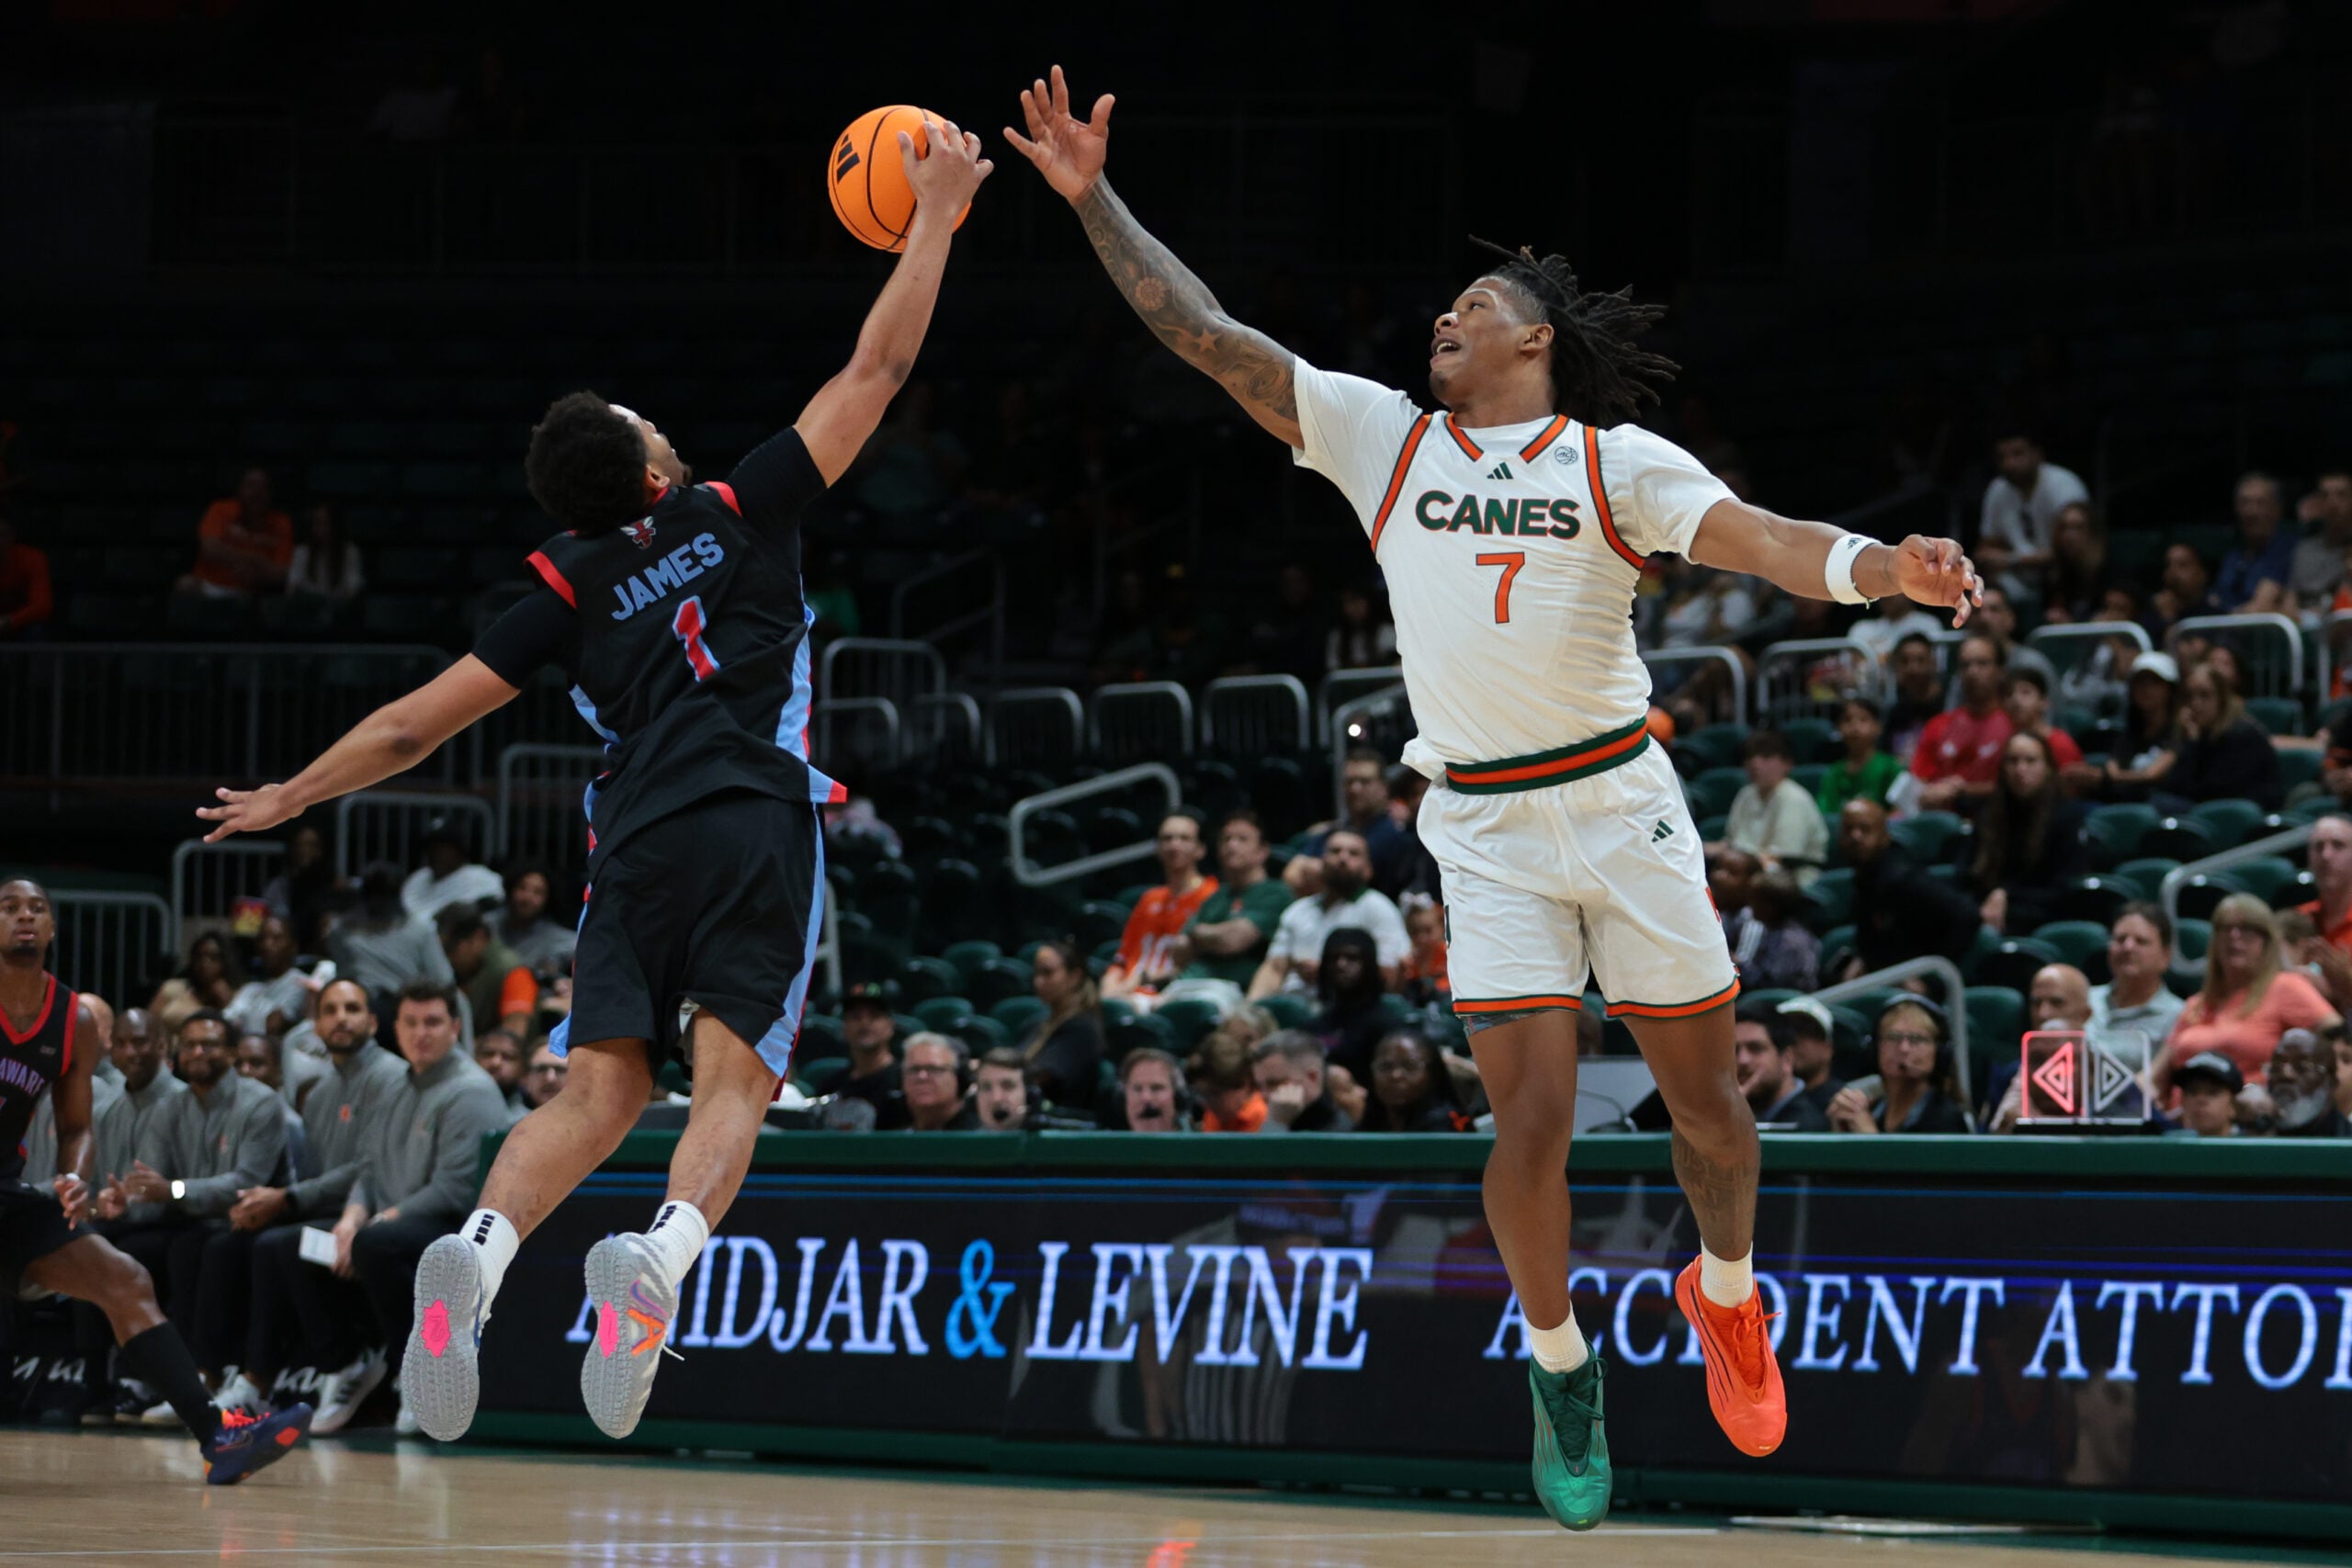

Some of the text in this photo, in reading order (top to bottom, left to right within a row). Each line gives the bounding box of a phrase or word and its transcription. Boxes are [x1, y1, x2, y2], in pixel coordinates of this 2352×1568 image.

[1416, 490, 1581, 540] CANES
[611, 532, 725, 621] JAMES
[1476, 551, 1525, 624] 7
[672, 594, 721, 682] 1
[565, 1235, 930, 1357] IDJAR
[944, 1238, 1017, 1359] &
[1024, 1240, 1374, 1371] LEVINE
